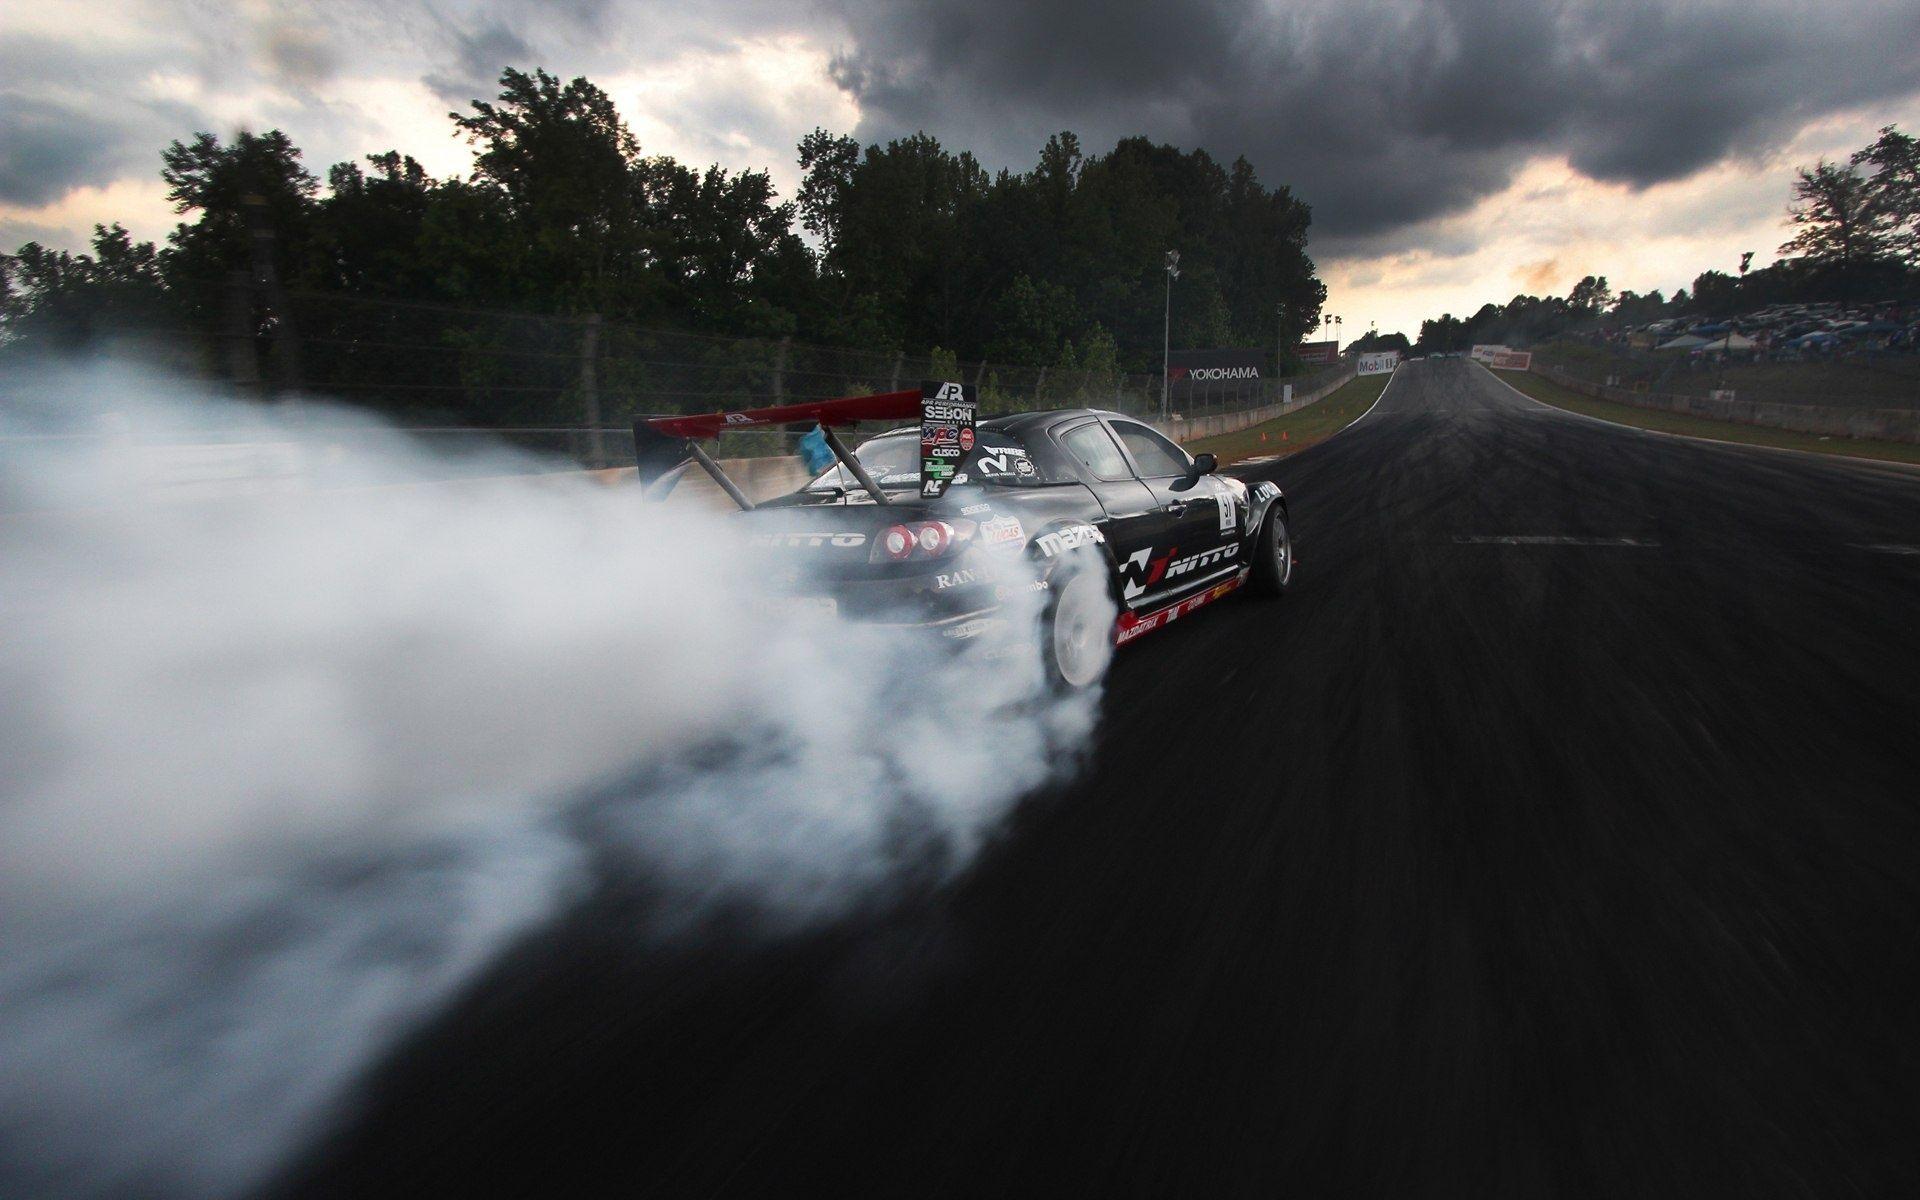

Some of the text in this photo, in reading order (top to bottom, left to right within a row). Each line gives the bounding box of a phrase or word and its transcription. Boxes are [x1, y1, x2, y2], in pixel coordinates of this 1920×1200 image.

[1189, 366, 1259, 380] YOKOHAMA
[1360, 360, 1385, 372] Mobil
[748, 532, 866, 547] ITTO
[1165, 542, 1239, 579] NITTO
